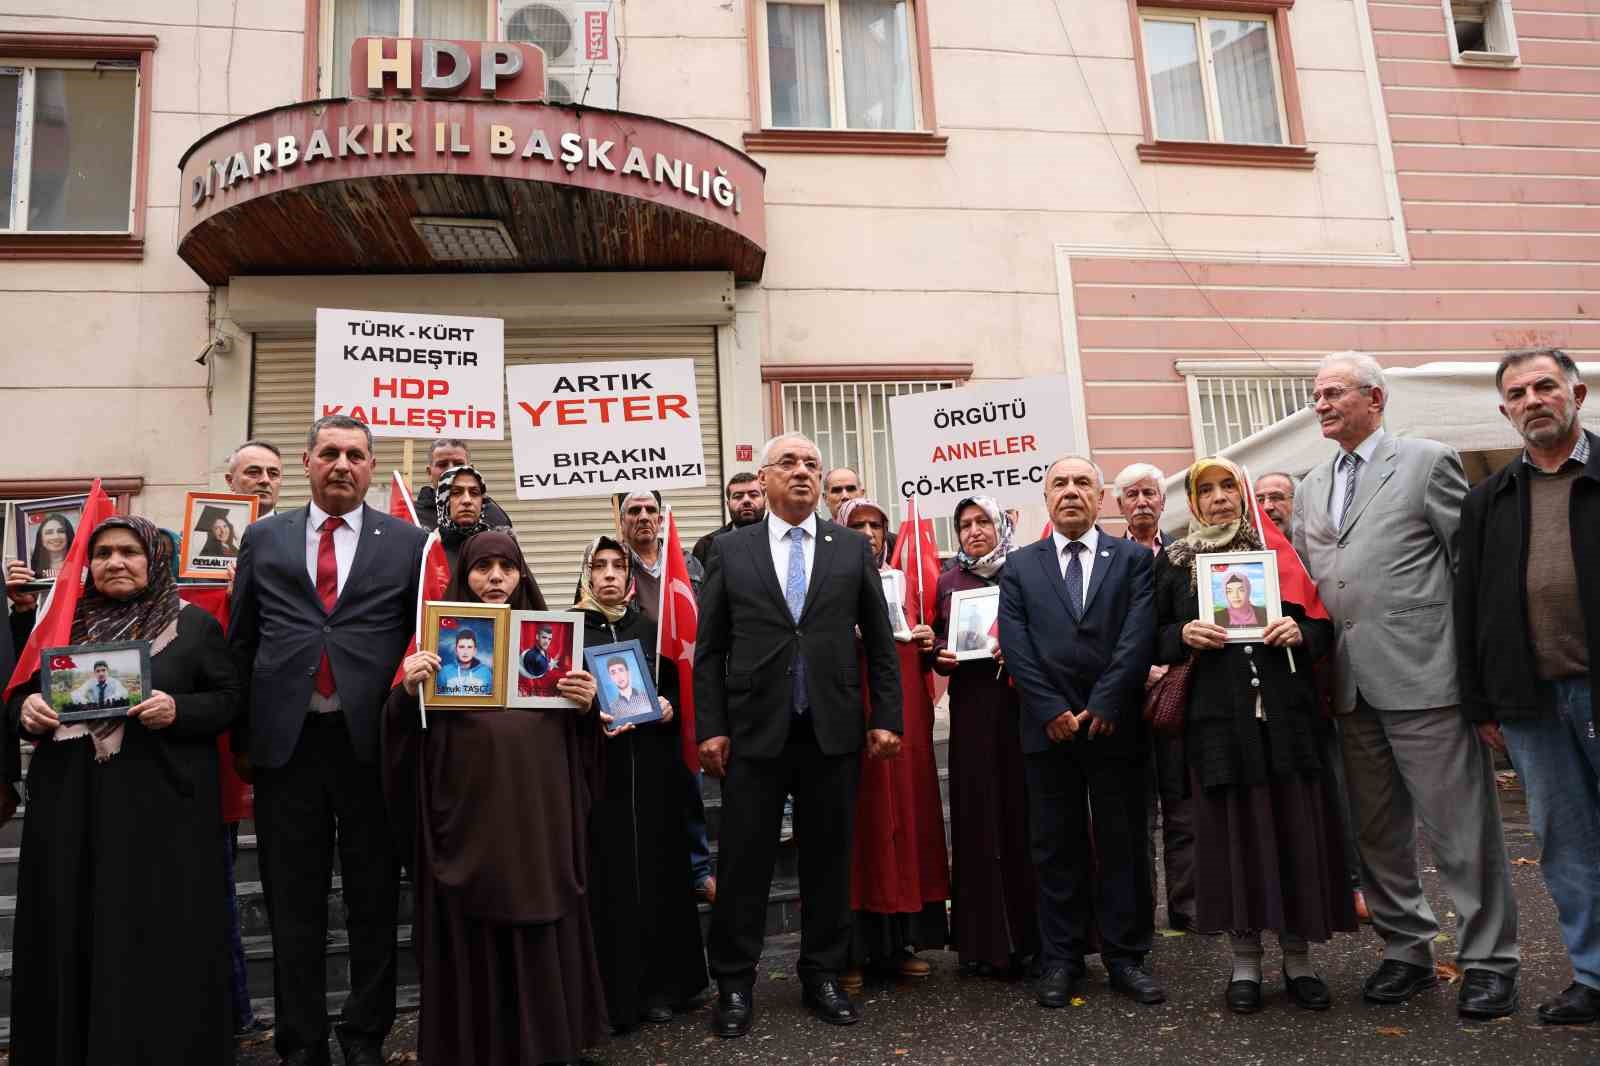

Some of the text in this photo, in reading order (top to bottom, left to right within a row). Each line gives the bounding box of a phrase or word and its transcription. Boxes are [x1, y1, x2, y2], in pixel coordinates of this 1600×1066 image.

[367, 38, 524, 91] HDP
[373, 377, 450, 400] HDP
[552, 373, 654, 394] ARTIK
[517, 394, 691, 427] YETER
[933, 399, 1027, 430] ÖRGÜTÜ
[553, 447, 667, 468] BIRAKIN
[931, 434, 1037, 464] ANNELER
[519, 463, 702, 488] EVLATLARIMIZI
[901, 465, 1049, 502] ÇÖ-KER-TE-C
